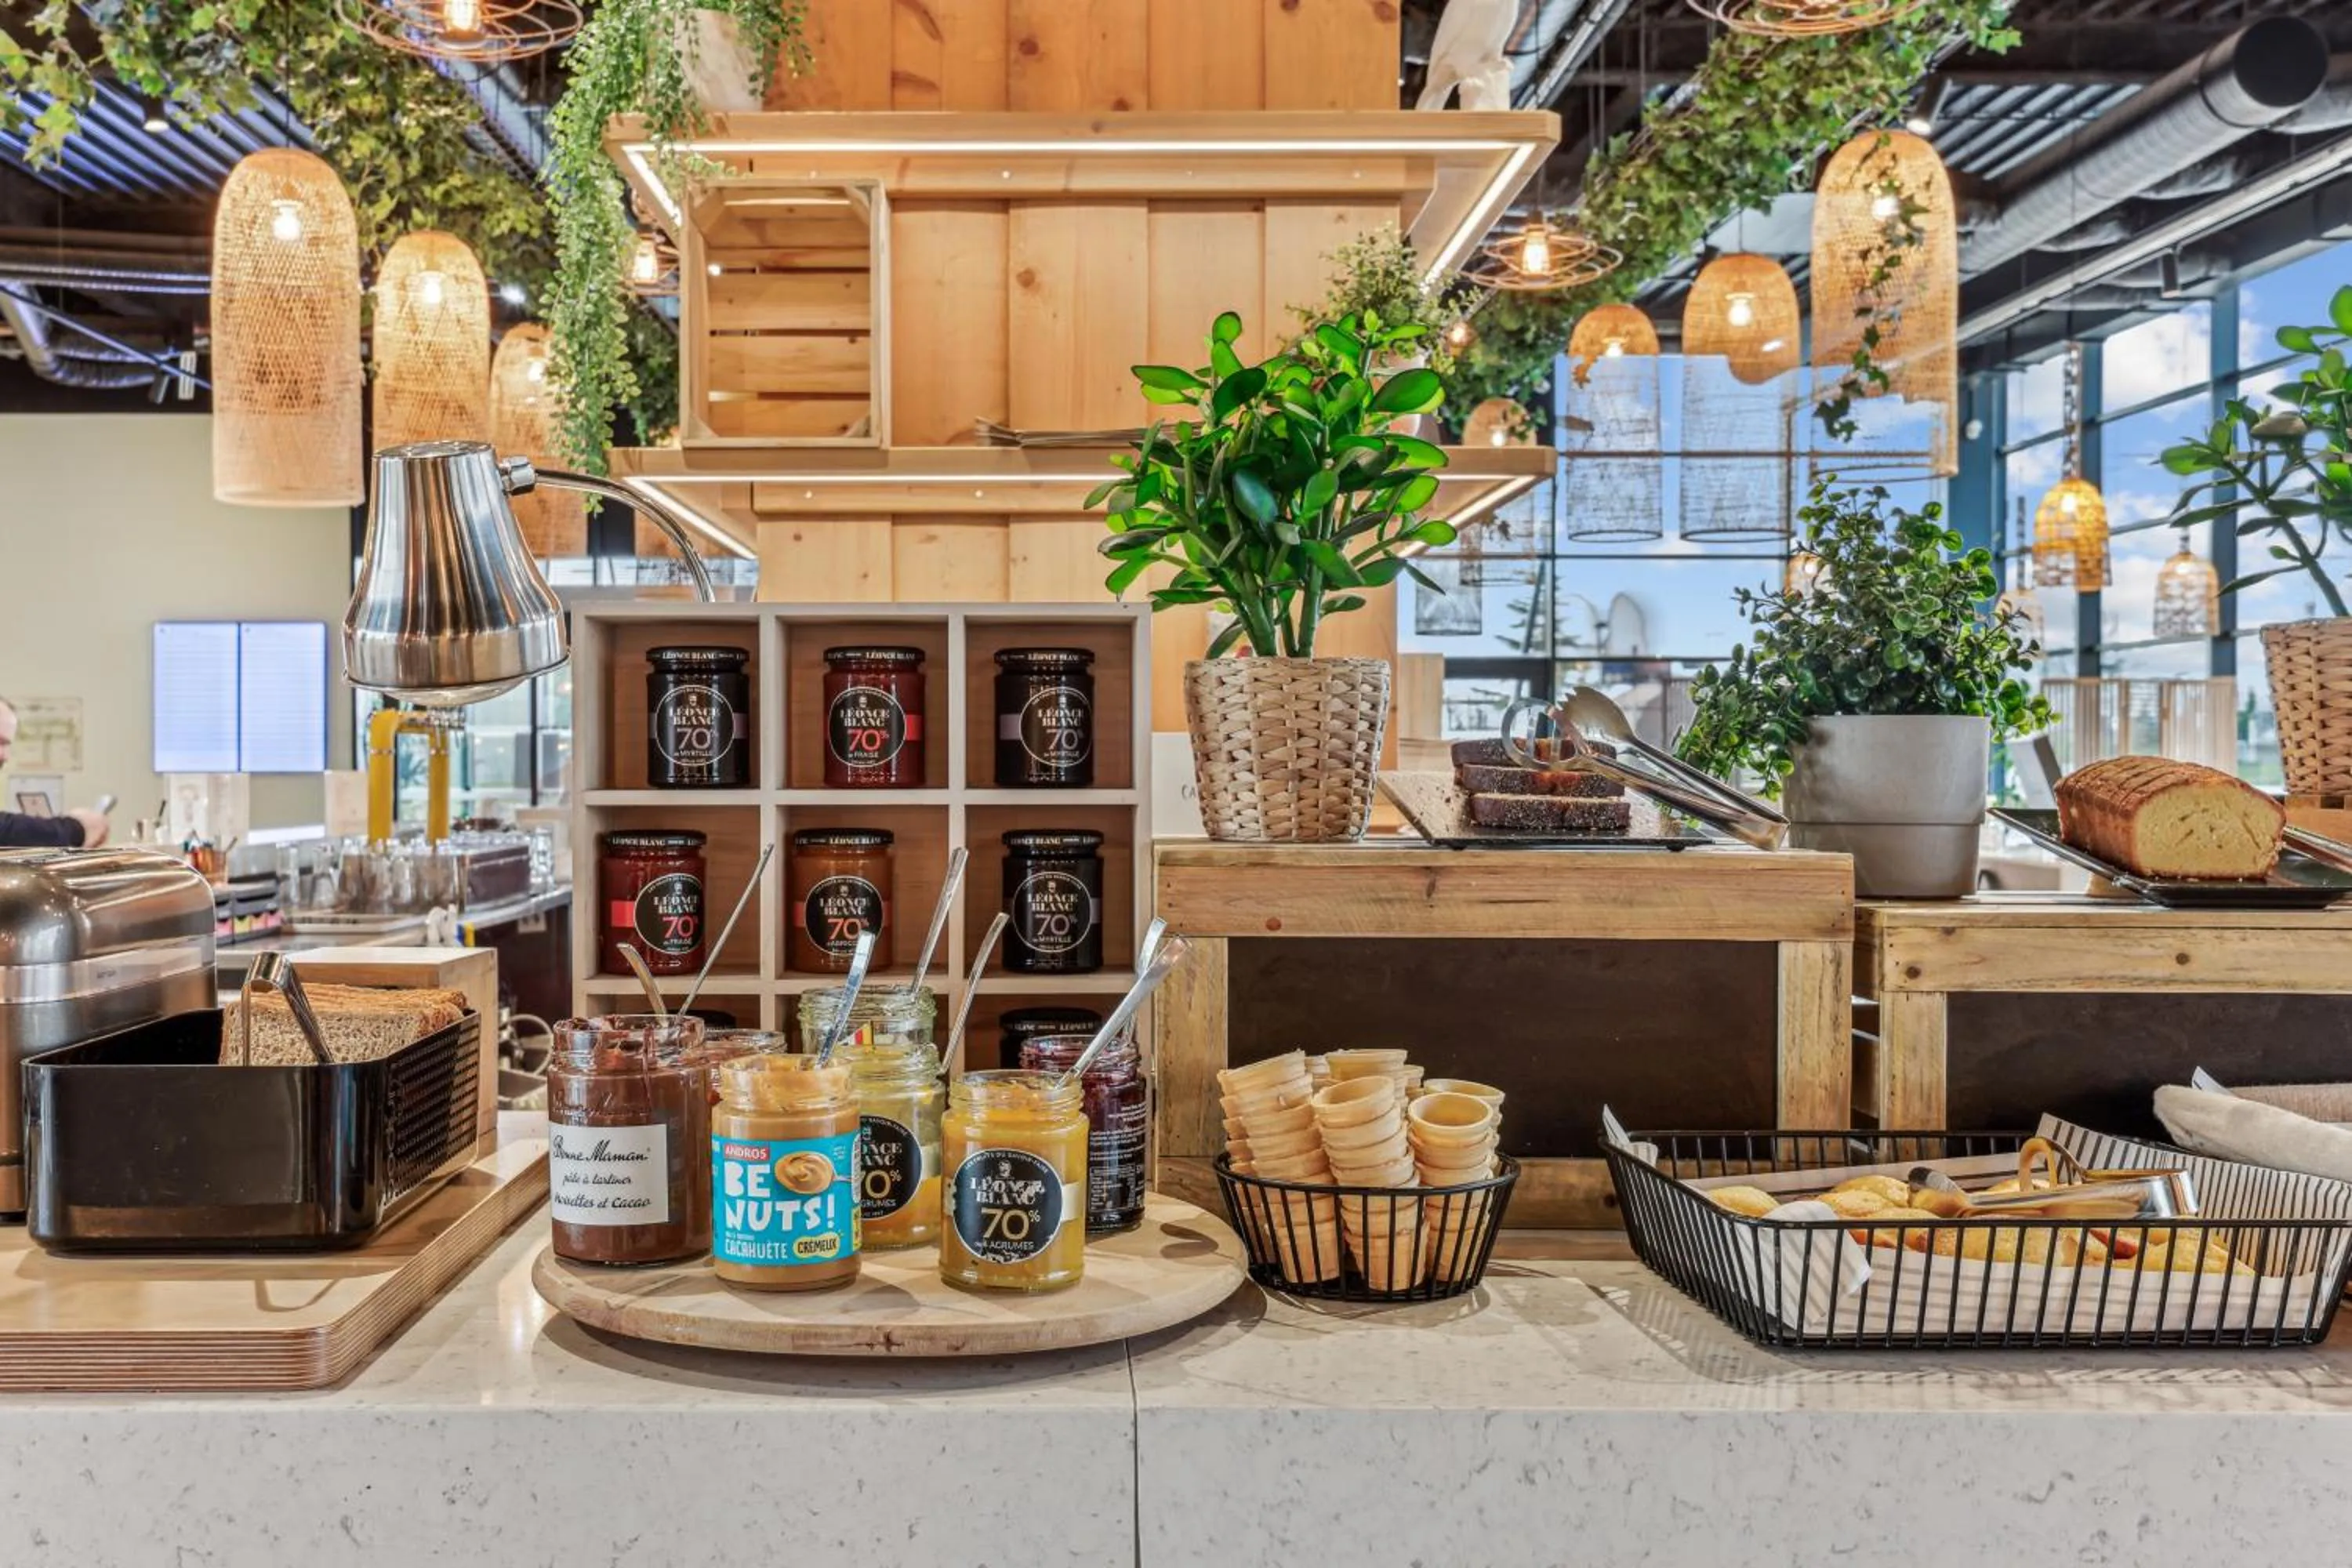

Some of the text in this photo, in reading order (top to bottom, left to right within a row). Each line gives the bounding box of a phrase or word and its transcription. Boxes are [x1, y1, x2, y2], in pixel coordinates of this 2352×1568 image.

[673, 716, 714, 725] BLANC
[844, 717, 884, 727] BLANC
[1042, 717, 1081, 727] BLANC
[659, 904, 696, 914] BLANC
[824, 906, 866, 916] BLANC
[1032, 902, 1073, 912] BLANC
[553, 1134, 649, 1163] Bonne Maman
[725, 1144, 768, 1160] ANDROS
[862, 1155, 896, 1166] ANC
[592, 1174, 633, 1185] tartiner
[724, 1160, 771, 1199] BE
[861, 1169, 902, 1200] 0%
[597, 1196, 609, 1209] et
[611, 1196, 653, 1209] Cacao
[976, 1191, 1036, 1205] BLANC
[724, 1193, 836, 1232] NUTS!
[981, 1207, 1041, 1240] 70%
[724, 1237, 788, 1260] CACAHUÈTE
[989, 1241, 1035, 1250] AGRUMES
